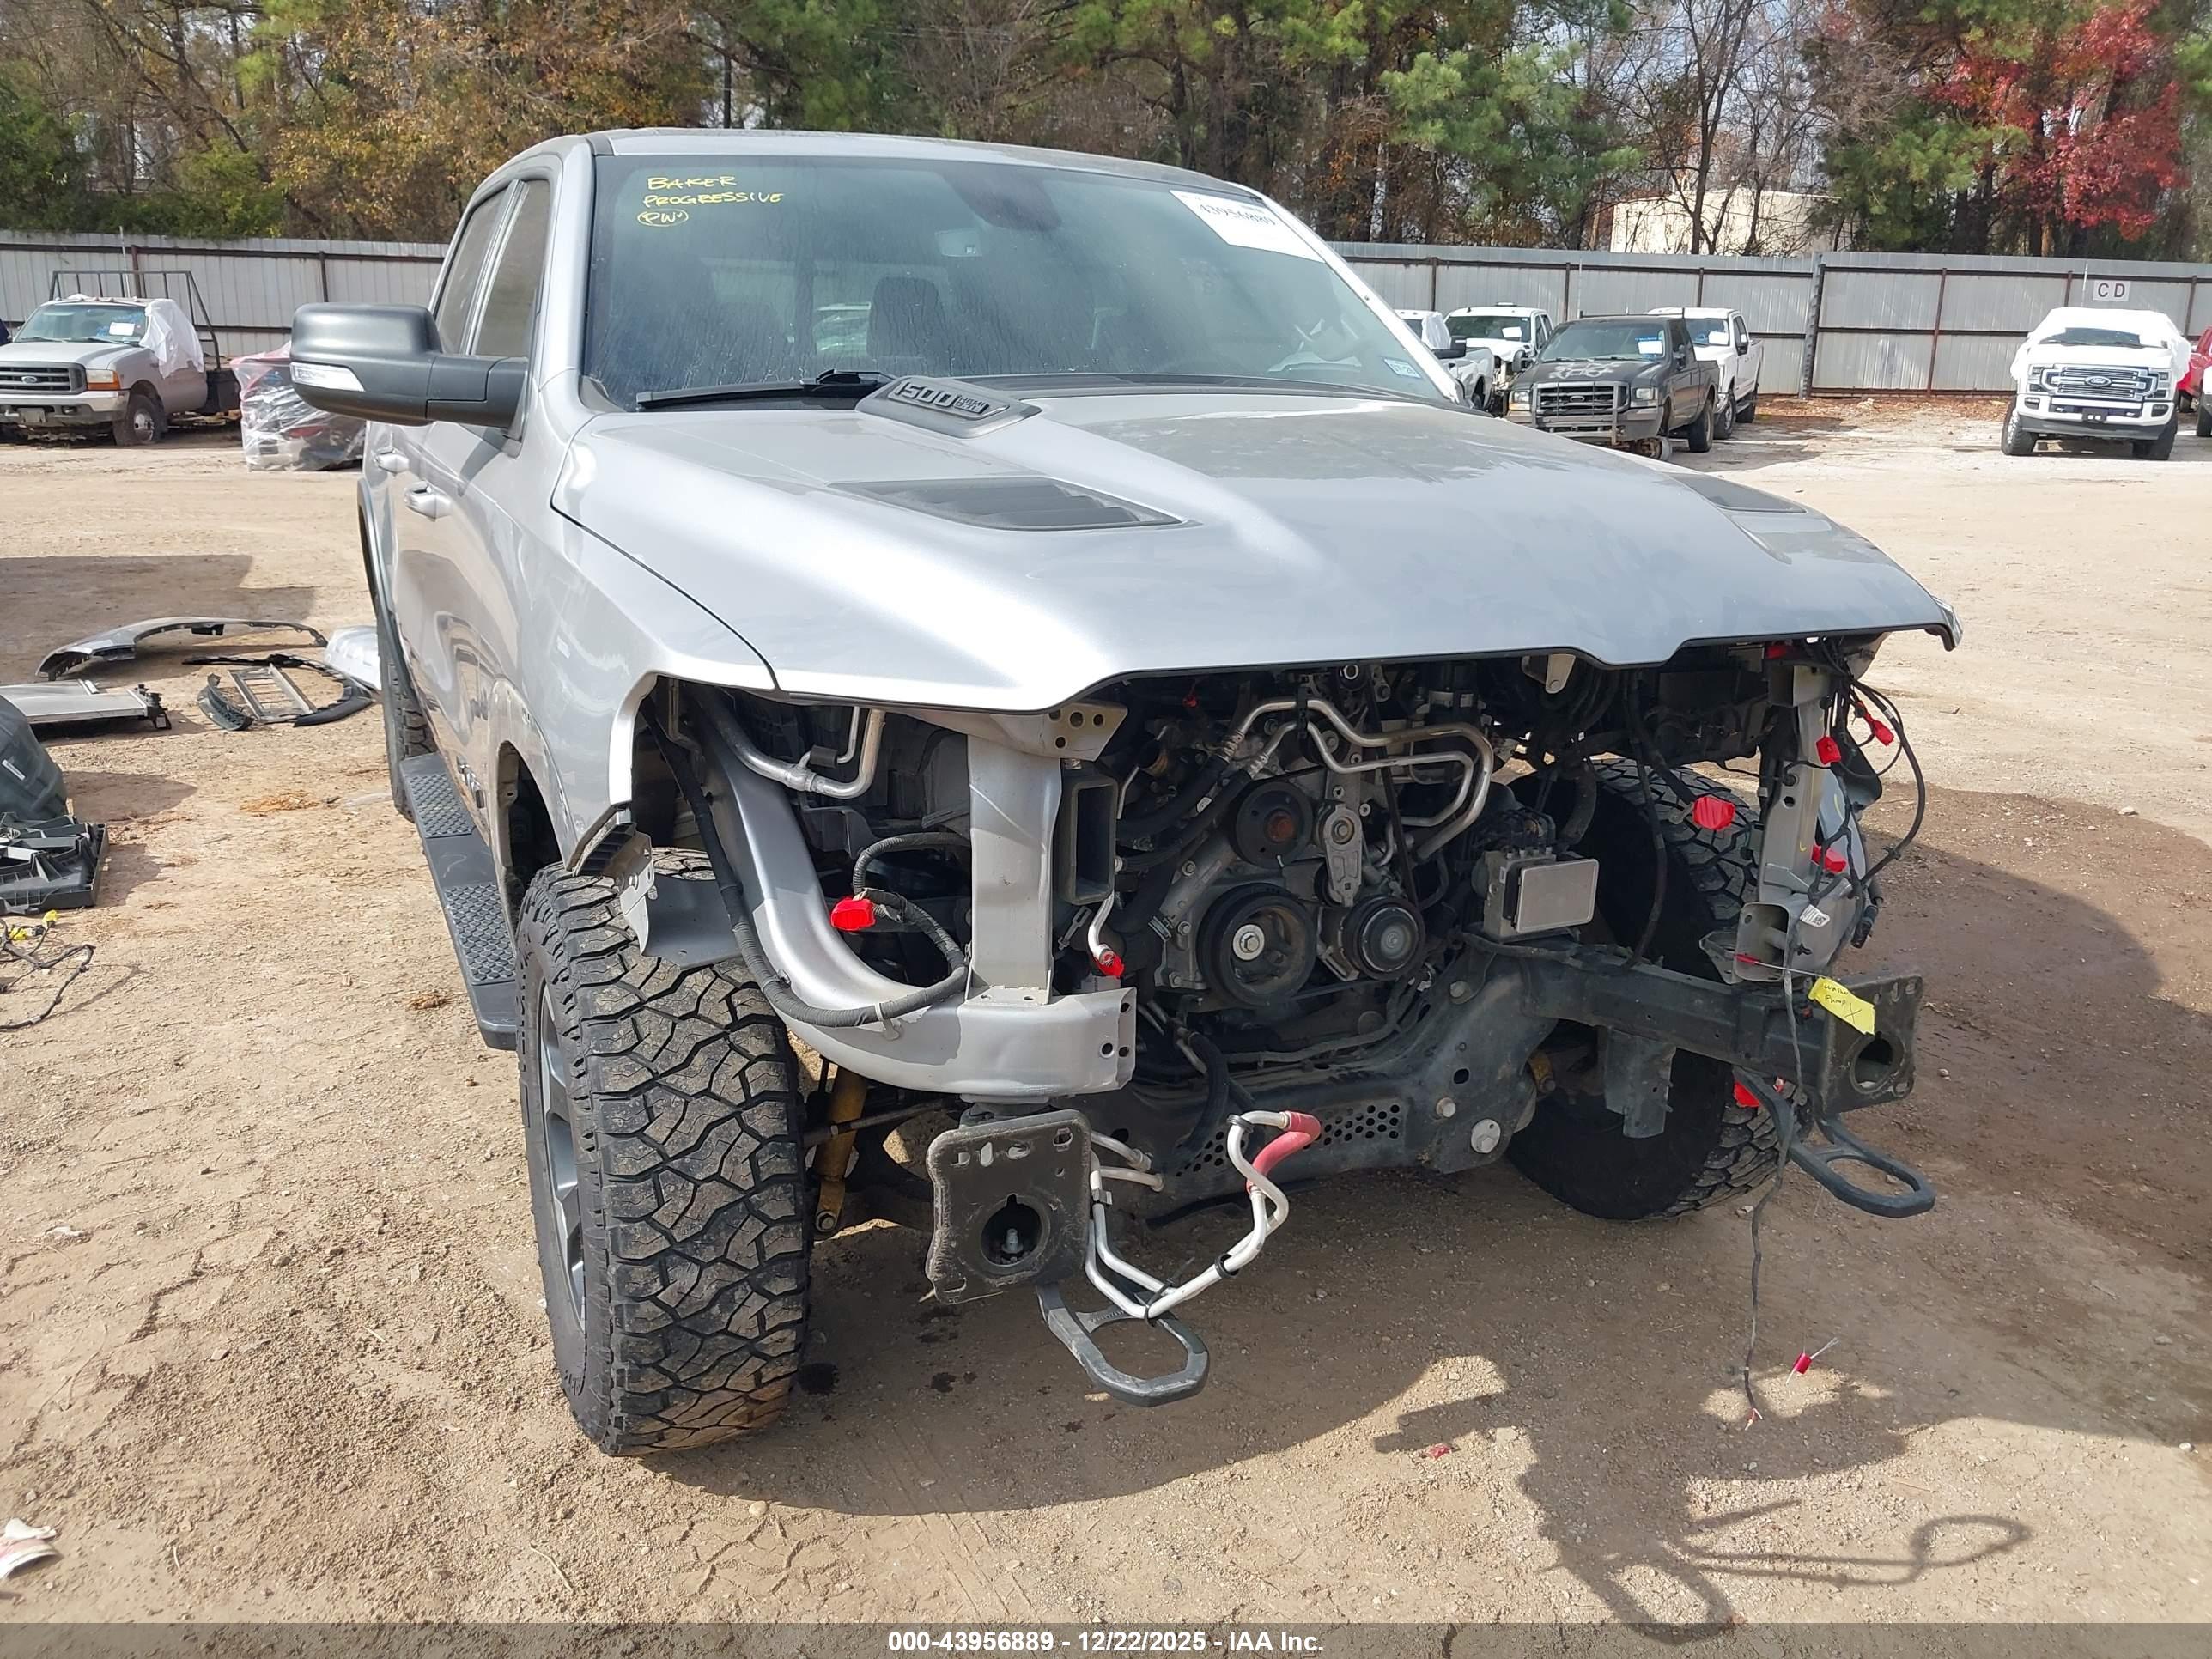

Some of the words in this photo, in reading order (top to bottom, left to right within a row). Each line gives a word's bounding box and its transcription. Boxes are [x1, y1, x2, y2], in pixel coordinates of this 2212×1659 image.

[647, 176, 737, 190] BAKER
[643, 192, 783, 207] PROGRESSIVE
[2098, 283, 2110, 297] C
[2114, 283, 2125, 297] D
[894, 381, 959, 407] 1500
